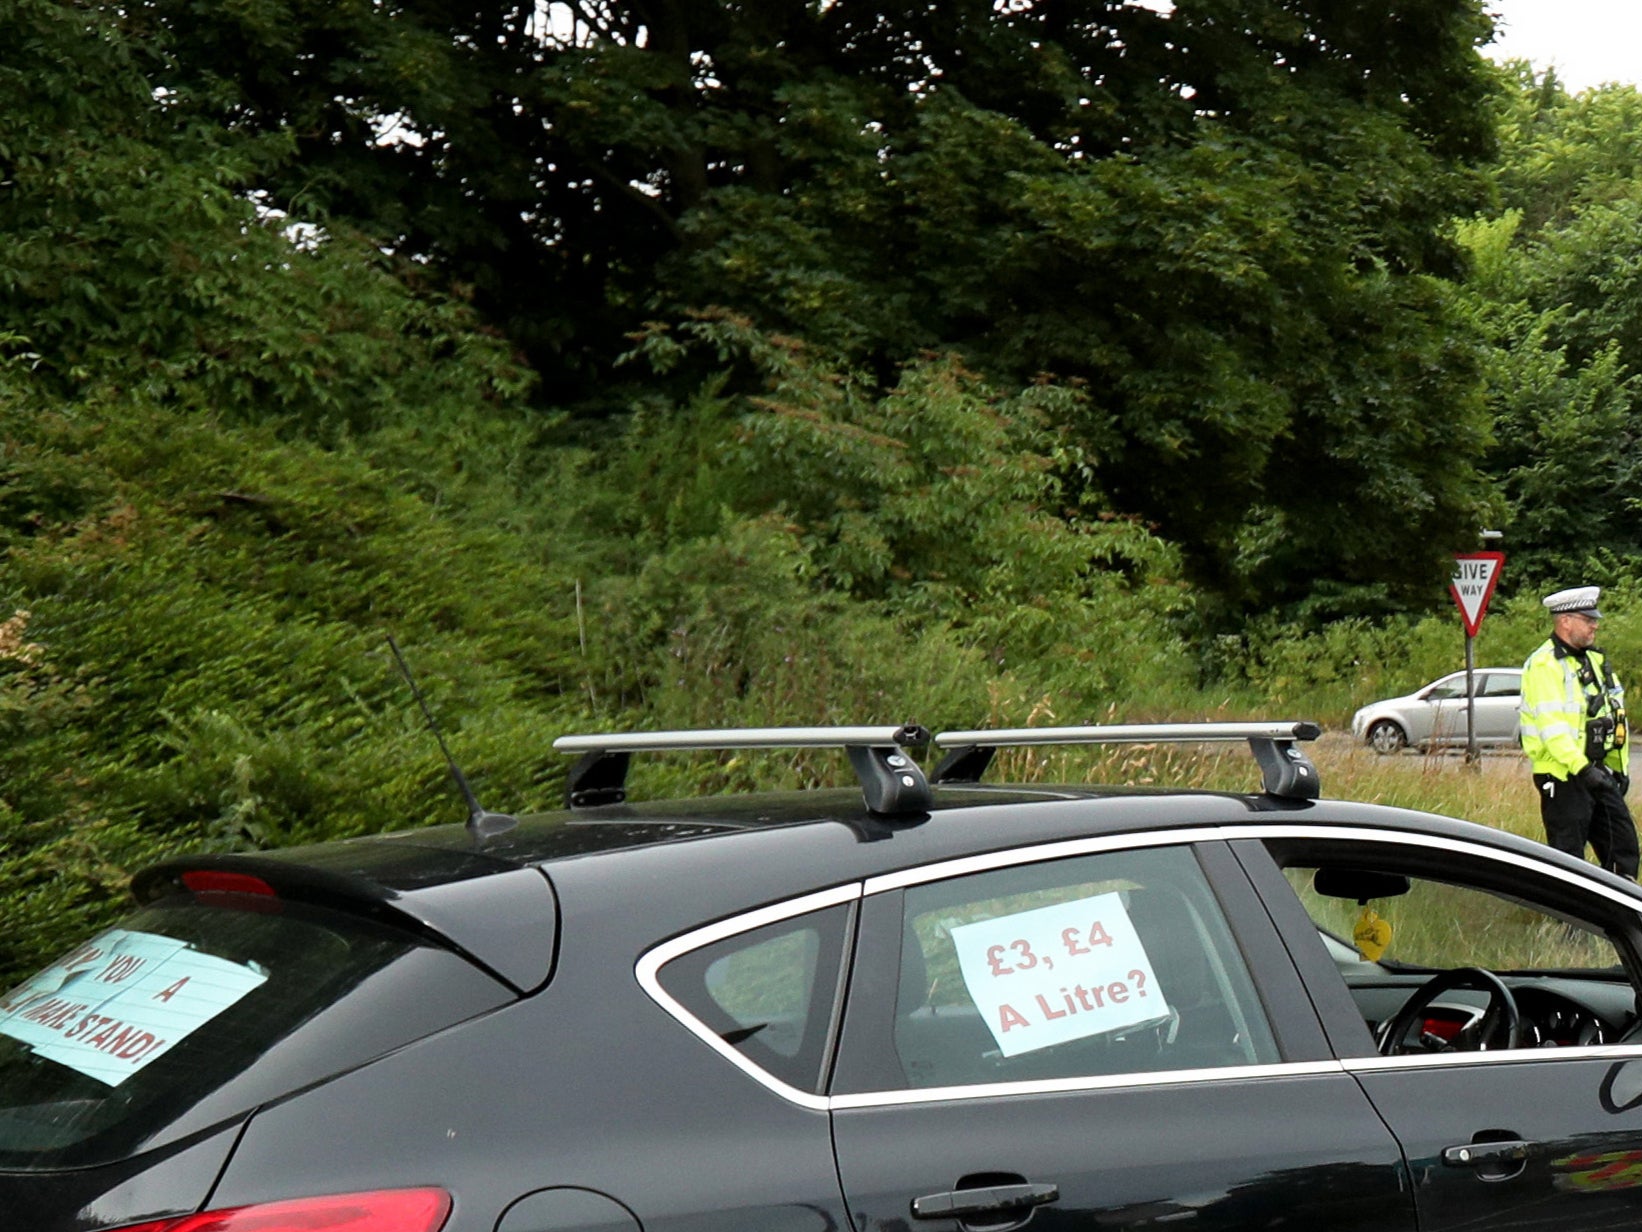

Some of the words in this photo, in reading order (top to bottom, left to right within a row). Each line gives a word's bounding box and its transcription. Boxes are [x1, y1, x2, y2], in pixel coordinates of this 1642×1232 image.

[1461, 585, 1483, 596] WAY
[985, 938, 1055, 977] £3,
[1061, 920, 1113, 957] £4
[94, 953, 147, 983] YOU
[152, 976, 192, 1003] A
[998, 1003, 1030, 1032] A
[1035, 968, 1148, 1021] Litre?
[20, 998, 88, 1030] MAKE
[64, 1013, 167, 1064] STAND!
